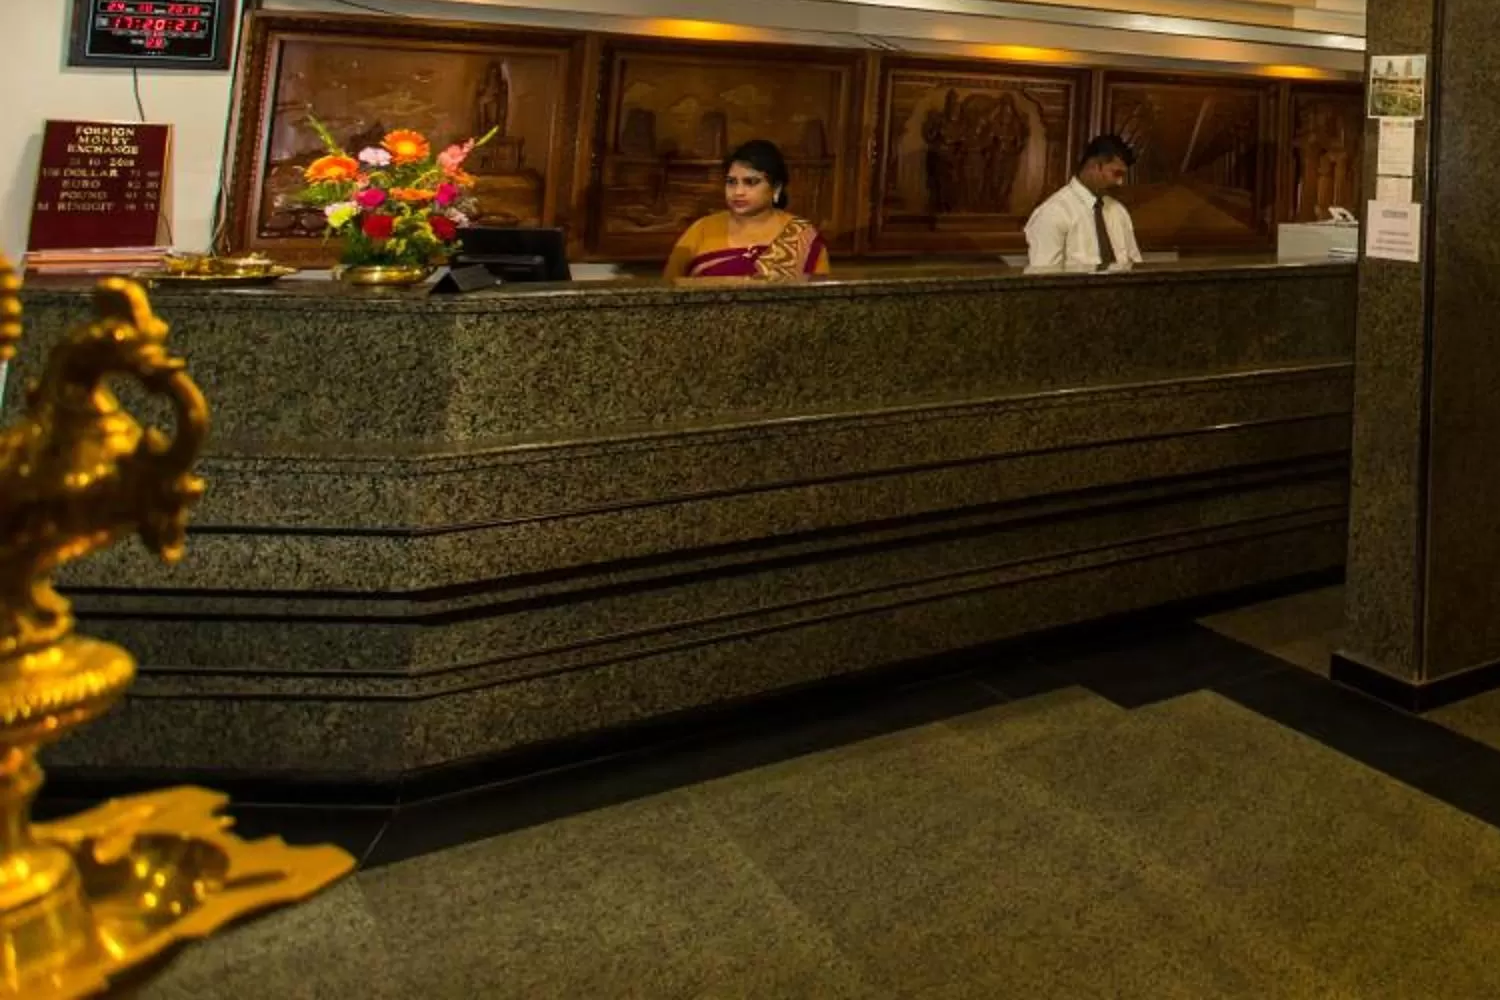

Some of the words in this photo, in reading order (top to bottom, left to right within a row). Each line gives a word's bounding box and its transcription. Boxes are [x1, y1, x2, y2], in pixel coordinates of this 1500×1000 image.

[75, 126, 135, 136] FOREIGN
[78, 136, 131, 144] MONEY
[67, 144, 139, 154] EXCHANGE
[63, 168, 119, 177] DOLLAR
[61, 180, 101, 188] EURO
